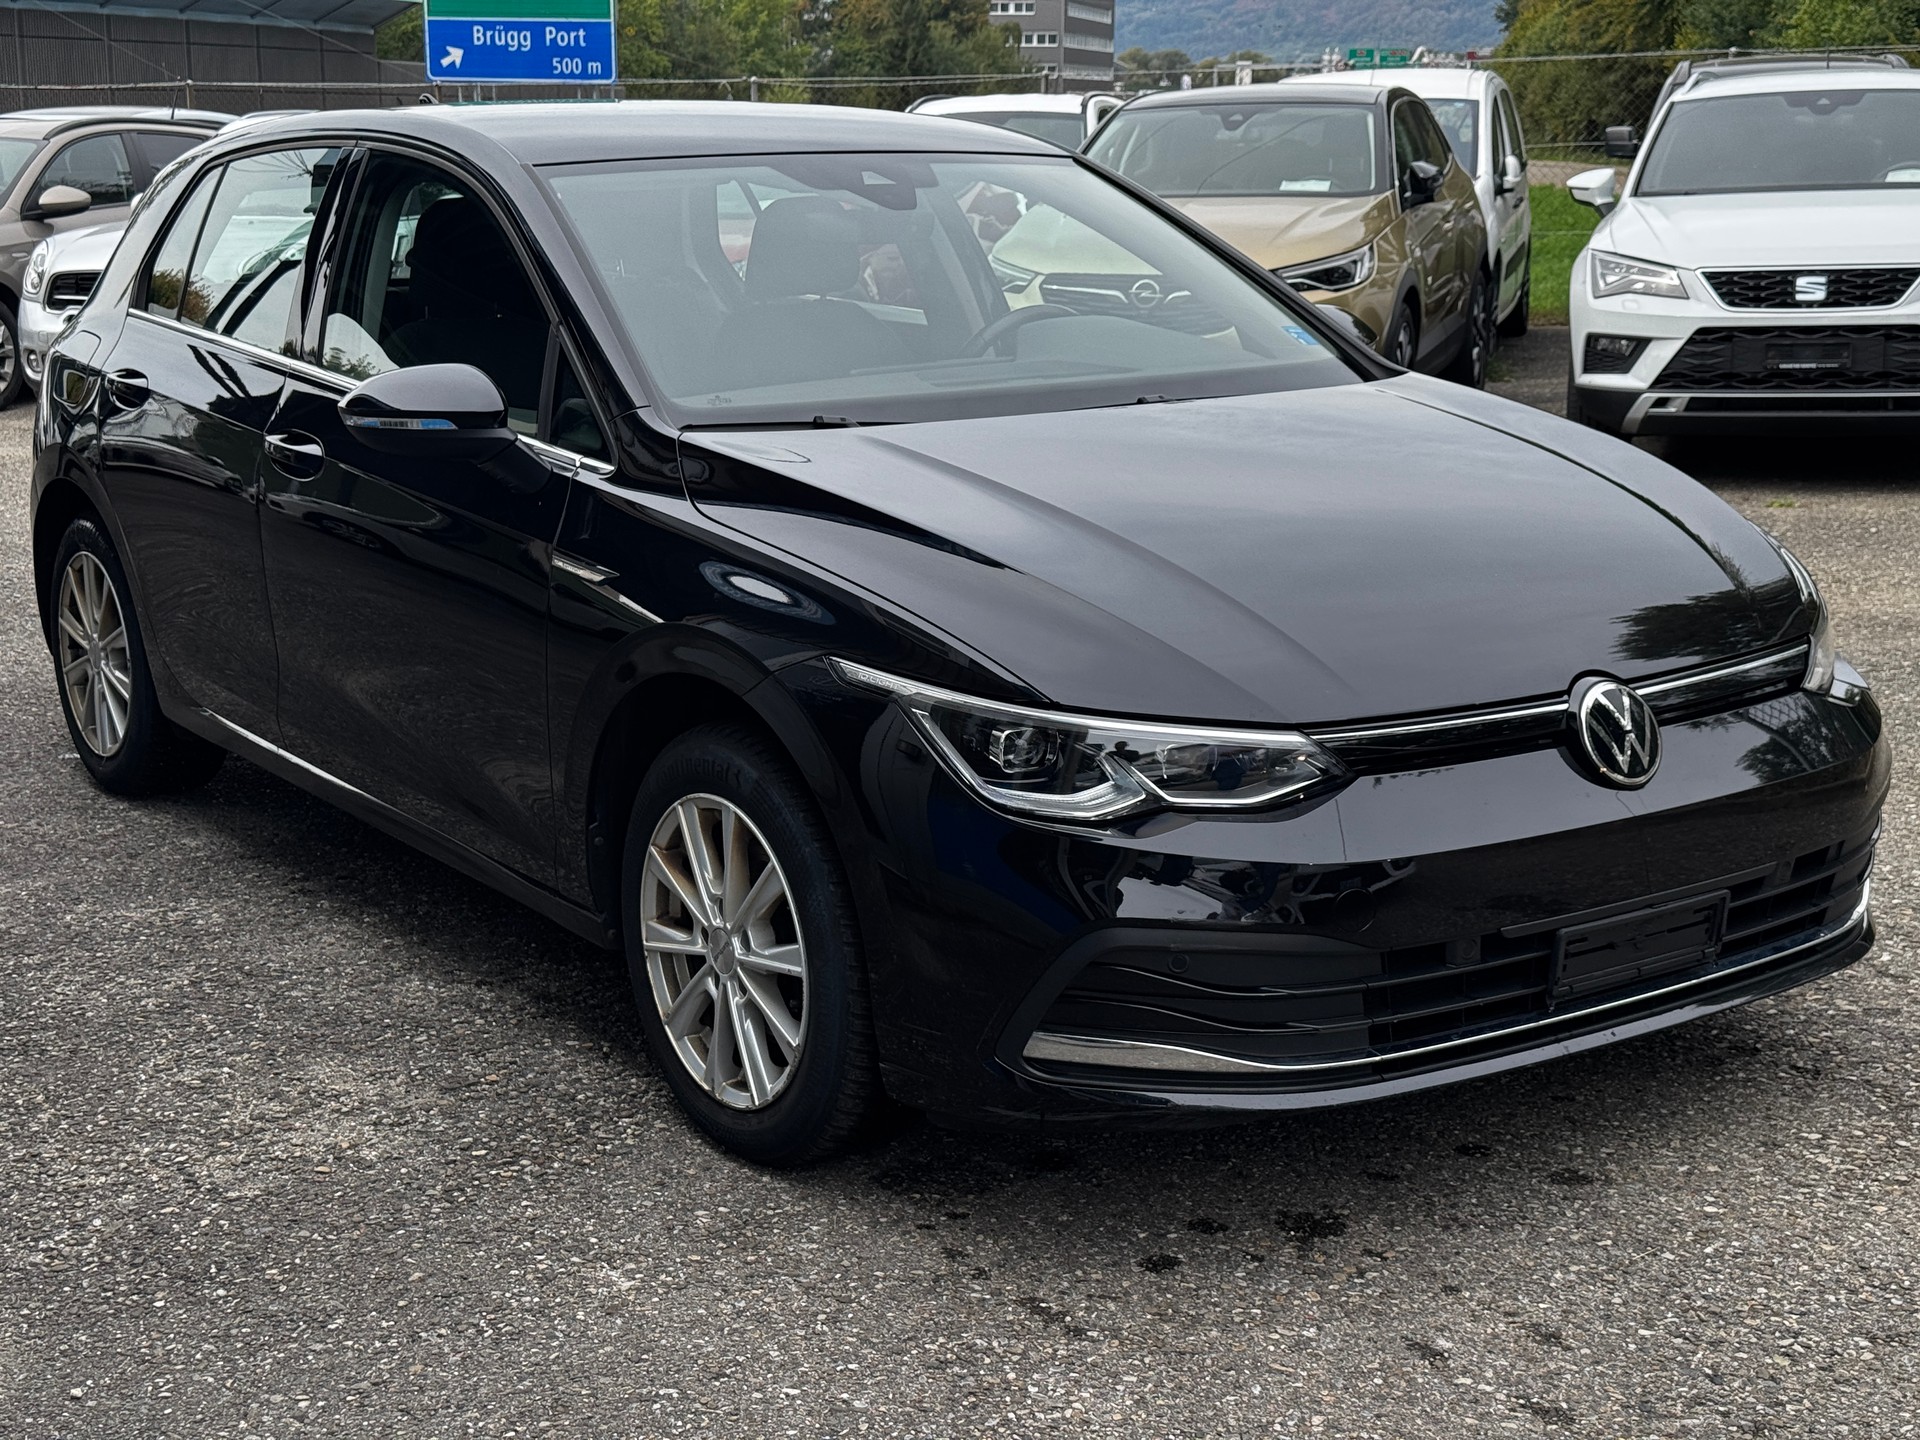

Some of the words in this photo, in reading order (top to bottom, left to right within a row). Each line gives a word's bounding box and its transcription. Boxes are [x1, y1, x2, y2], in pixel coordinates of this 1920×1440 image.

[473, 25, 531, 51] Brügg
[545, 26, 587, 47] Port
[552, 57, 582, 75] 500
[587, 61, 601, 75] m
